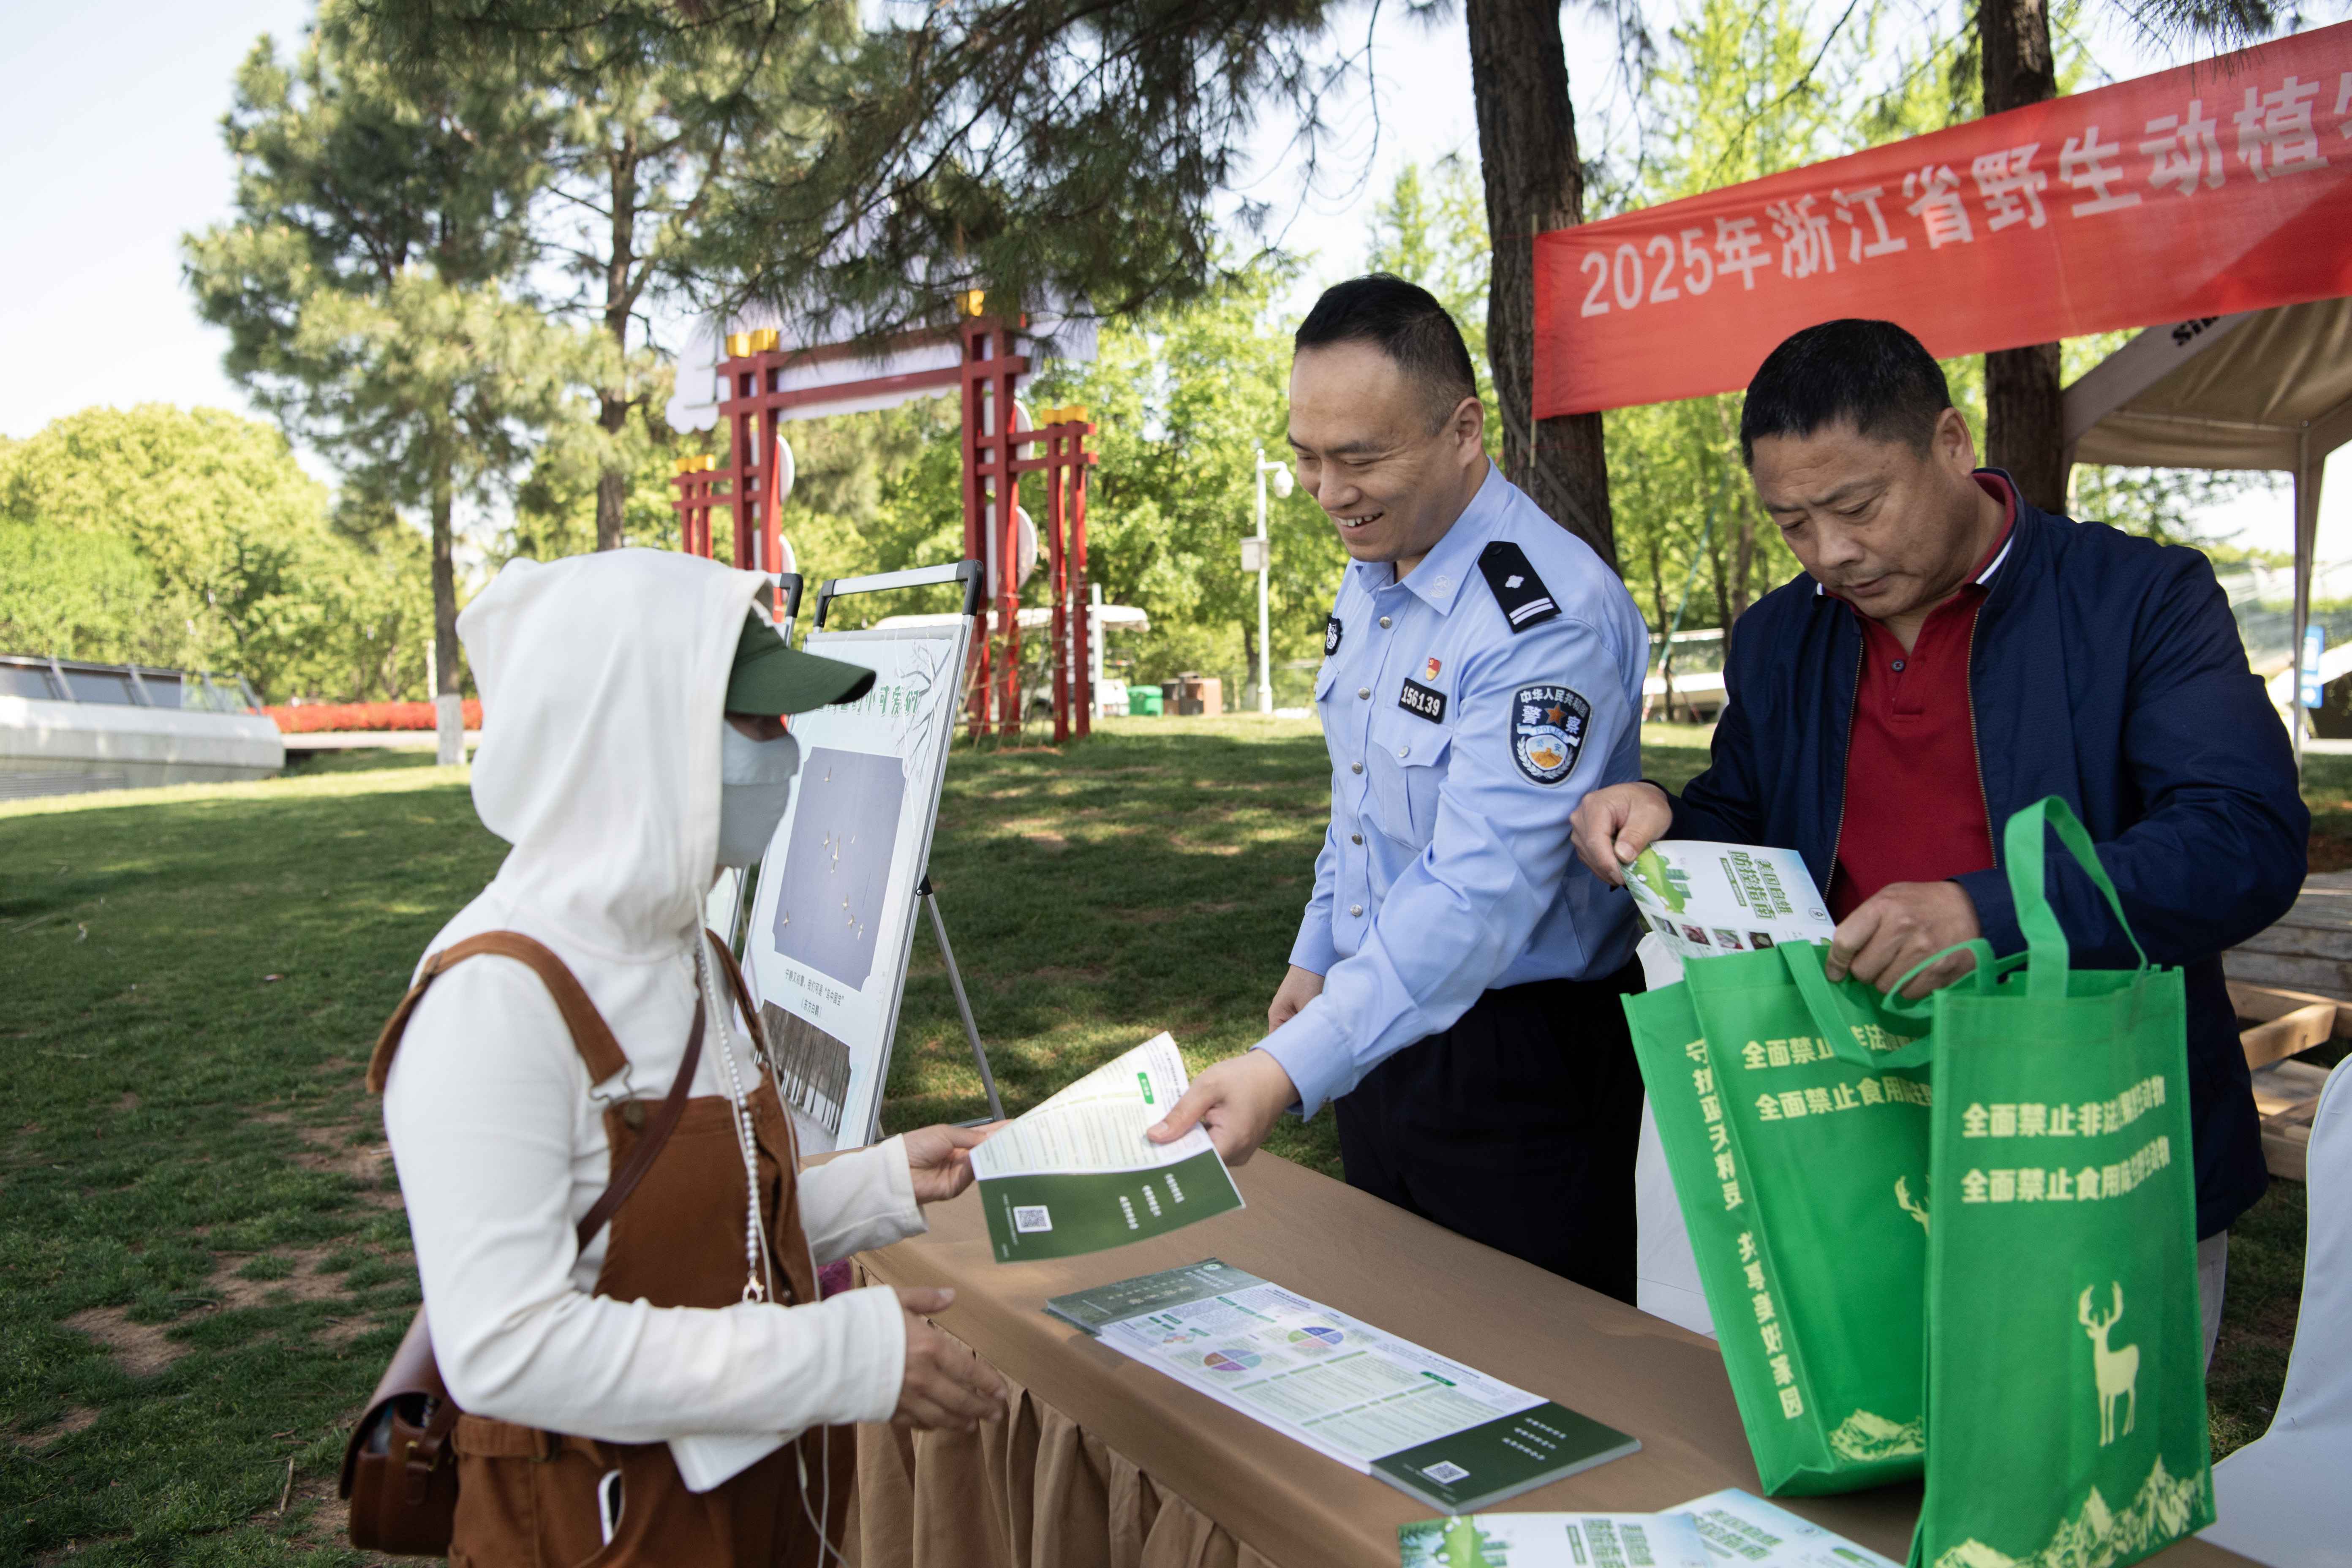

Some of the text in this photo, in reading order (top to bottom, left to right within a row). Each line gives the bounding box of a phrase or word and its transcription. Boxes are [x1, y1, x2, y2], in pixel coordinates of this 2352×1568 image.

[1401, 685, 1440, 716] 156139
[1520, 688, 1589, 718] 中华人民共和国
[1535, 726, 1566, 740] POLICE
[1728, 849, 1777, 920] 防控指南
